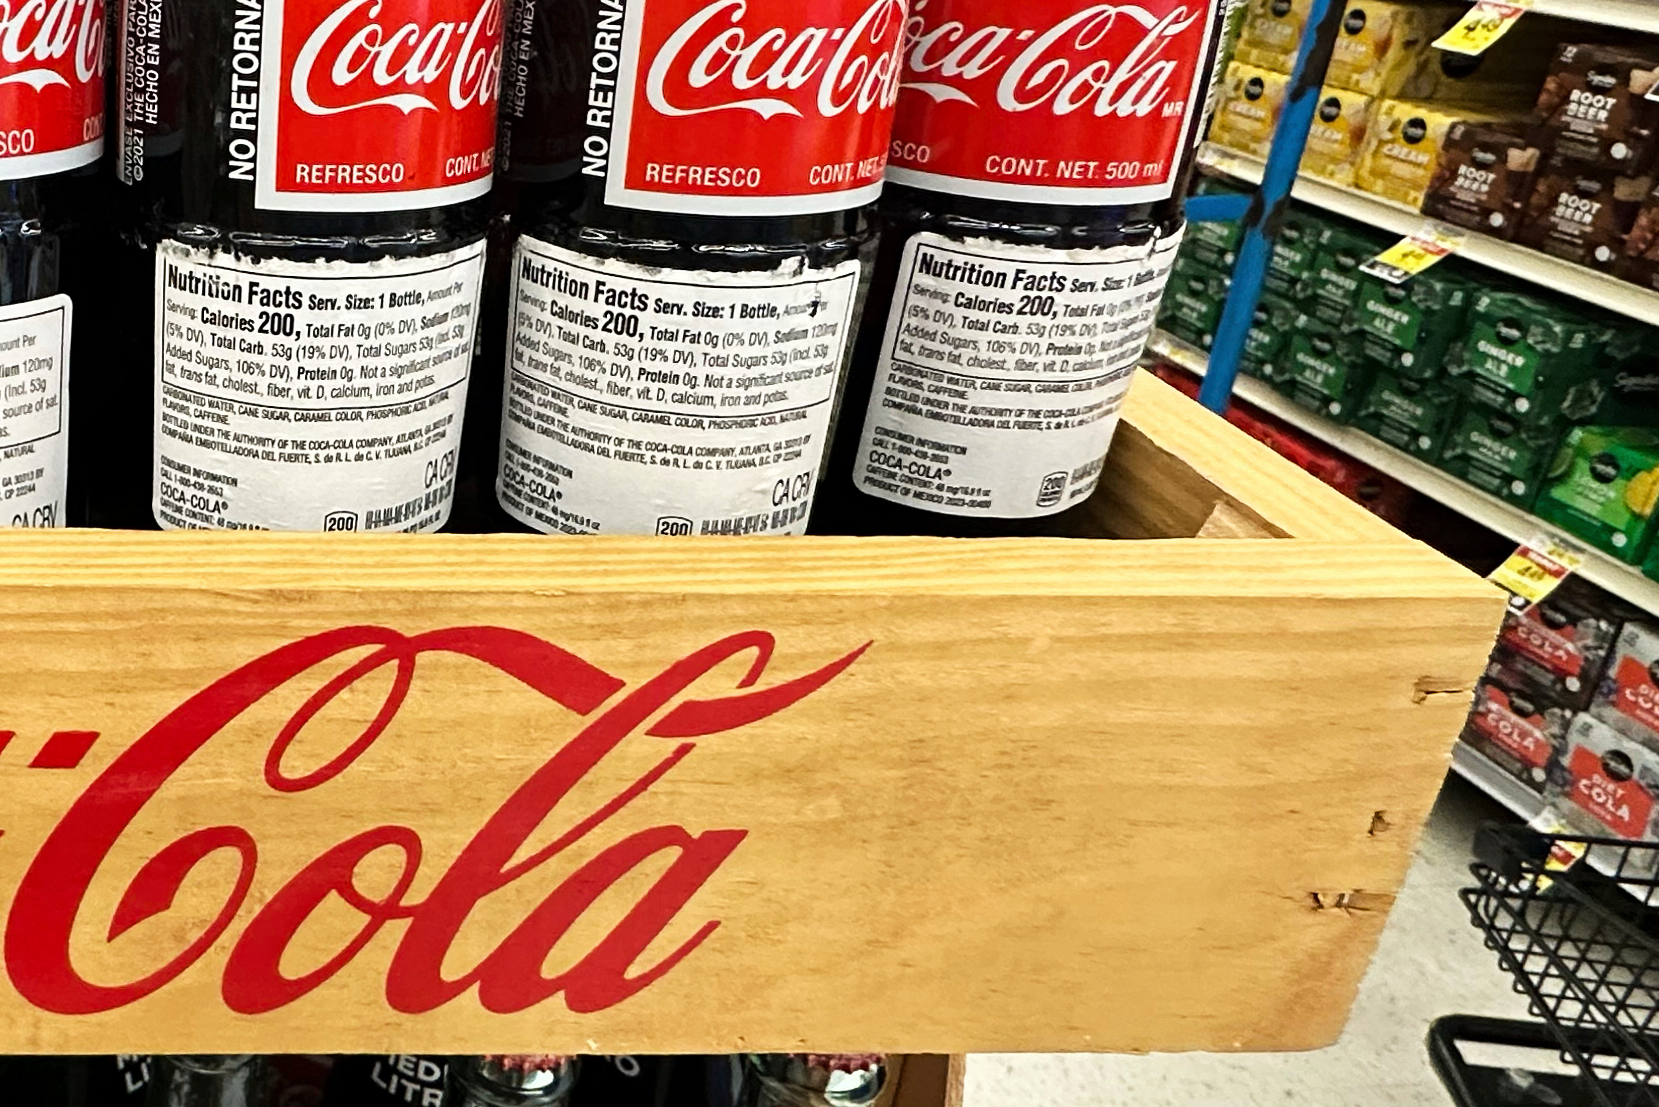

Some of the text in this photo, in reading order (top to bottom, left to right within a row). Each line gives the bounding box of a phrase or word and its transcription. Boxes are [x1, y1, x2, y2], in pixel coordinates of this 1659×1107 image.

[147, 43, 161, 67] EN
[519, 38, 532, 63] EN
[144, 70, 160, 126] HECHO
[513, 63, 529, 120] HECHO
[1568, 88, 1617, 111] ROOT
[134, 94, 145, 124] THE
[1566, 104, 1609, 123] BEER
[229, 146, 257, 181] NO
[295, 150, 480, 184] REFRESCO CONT.
[582, 139, 609, 178] NO
[985, 155, 1049, 178] CONT.
[1056, 160, 1100, 180] NET.
[1105, 159, 1139, 180] 500
[1383, 143, 1431, 164] CREAM
[645, 163, 761, 188] REFRESCO
[809, 160, 855, 186] CONT.
[1455, 176, 1490, 192] BEER
[1457, 163, 1497, 184] ROOT
[1558, 191, 1603, 215] ROOT
[167, 263, 426, 311] Nutrition Facts Serv. Size: 1 Bottle,
[521, 255, 781, 320] Nutrition Facts Serv. Size: 1 Bottle,
[918, 252, 1068, 293] Nutrition Facts
[954, 291, 1058, 320] Calories 200,
[200, 306, 302, 342] Calories 200,
[550, 299, 645, 343] Calories 200,
[1477, 340, 1526, 367] GINGER
[328, 516, 354, 532] 200
[1517, 625, 1570, 662] COLA
[1487, 713, 1536, 752] COLA
[1578, 777, 1630, 822] COLA
